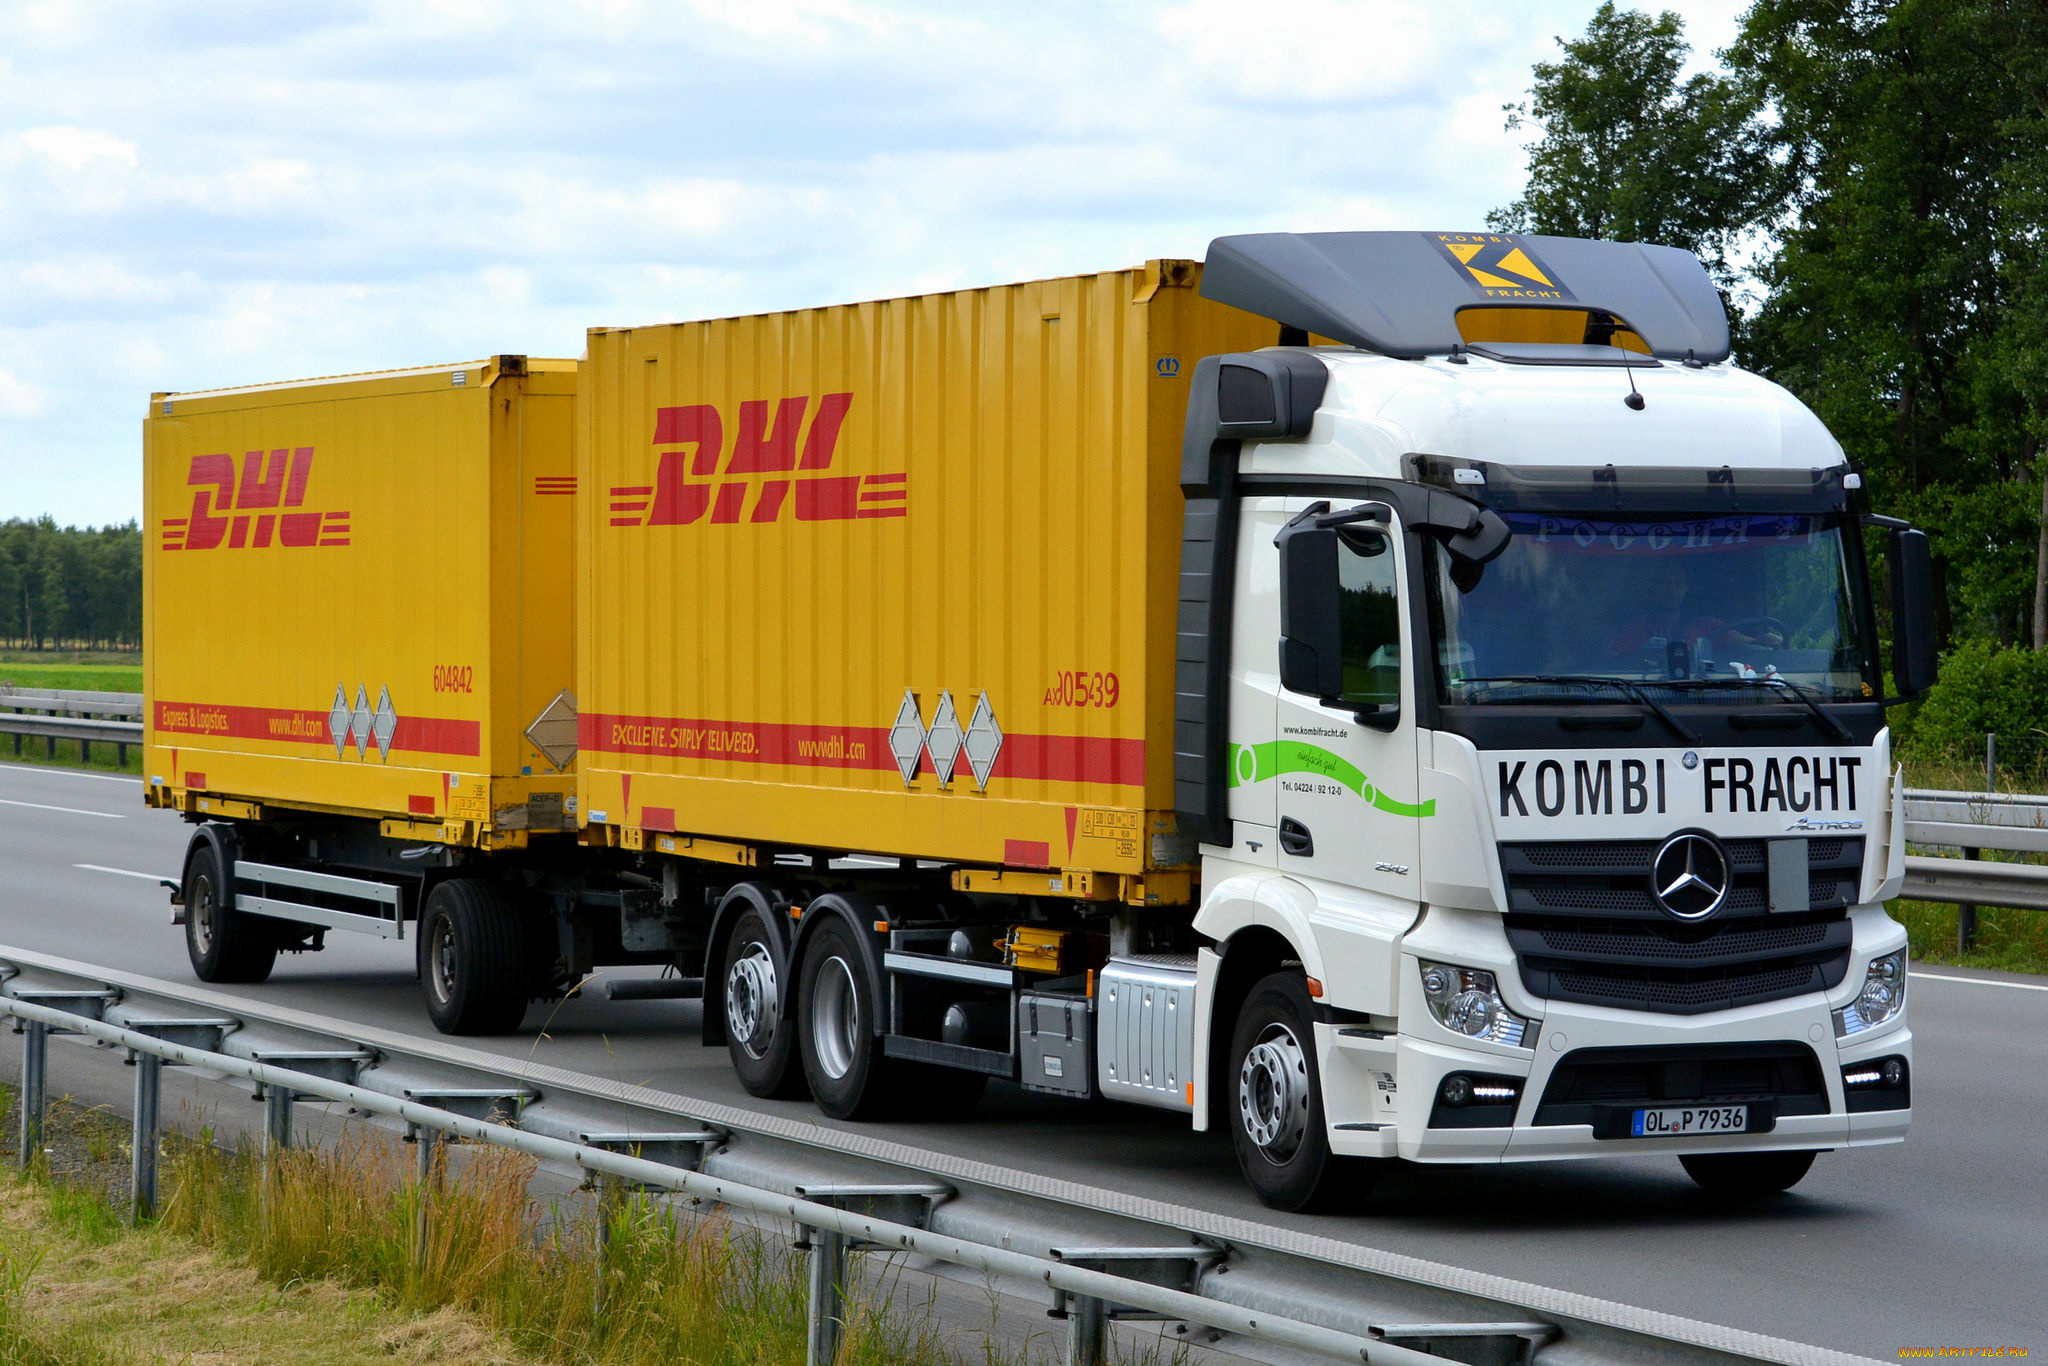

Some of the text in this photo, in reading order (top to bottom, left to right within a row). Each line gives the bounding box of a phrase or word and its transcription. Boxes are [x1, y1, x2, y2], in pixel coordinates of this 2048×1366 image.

[1438, 235, 1513, 244] KOMBI
[1486, 289, 1561, 298] FRACHT
[647, 392, 861, 526] DHL
[185, 447, 323, 550] DHL
[433, 664, 473, 693] 604842
[163, 706, 188, 731] Express
[190, 707, 196, 727] &
[269, 713, 323, 737] www.dhl.com
[1283, 726, 1348, 739] www.kombifracht.de
[1282, 781, 1293, 791] Tel.
[1294, 782, 1313, 793] 04224
[1318, 784, 1326, 794] 92
[1328, 785, 1342, 796] 12-0
[1498, 756, 1862, 817] KOMBI FRACHT
[1374, 861, 1409, 875] 2542
[1646, 1108, 1743, 1131] OL P 7936
